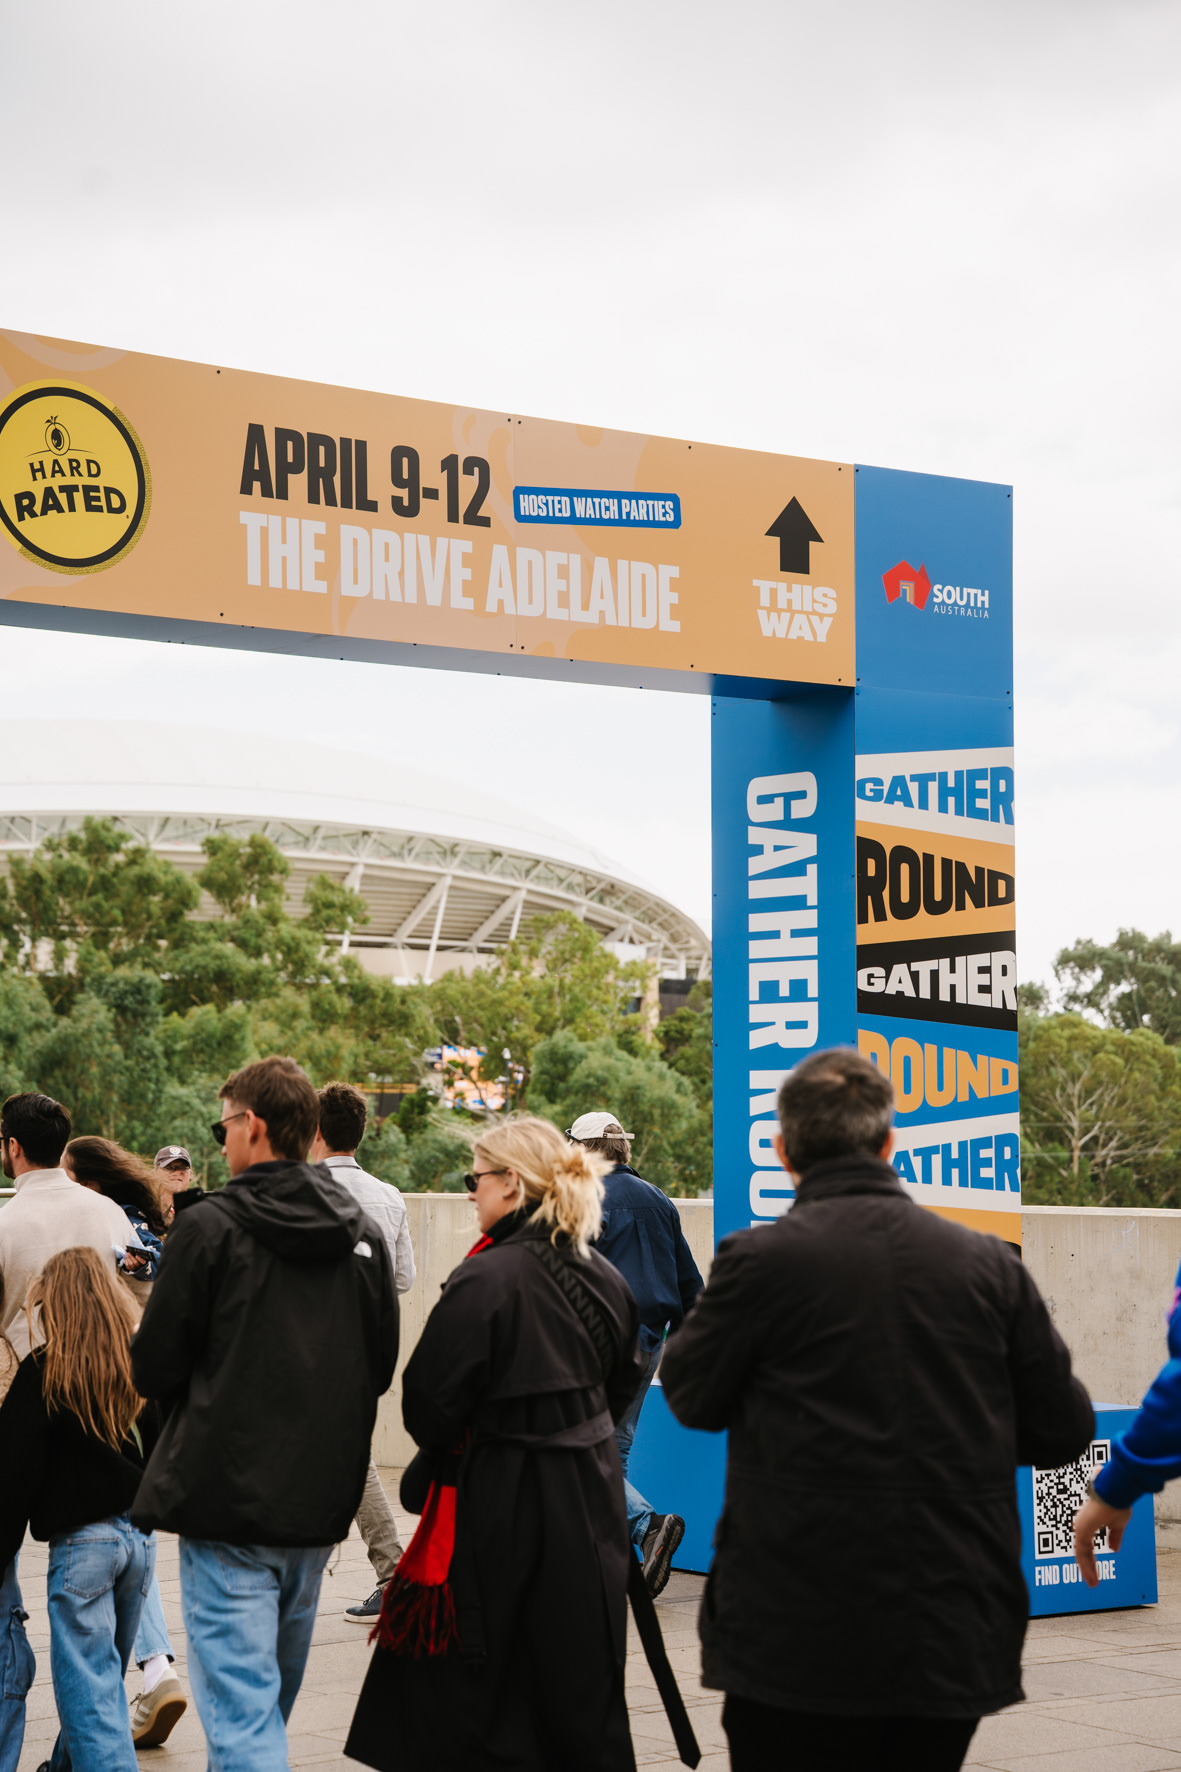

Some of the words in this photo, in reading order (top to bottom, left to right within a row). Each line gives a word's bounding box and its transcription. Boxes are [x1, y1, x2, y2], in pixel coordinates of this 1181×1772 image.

[29, 458, 101, 482] HARD
[240, 423, 378, 513] APRIL
[391, 445, 491, 528] 9-12
[14, 484, 126, 522] RATED
[519, 494, 570, 517] HOSTED
[573, 496, 619, 520] WATCH
[621, 498, 675, 522] PARTIES
[240, 511, 328, 594] THE
[340, 524, 475, 610] DRIVE
[485, 543, 681, 633] ADELAIDE
[752, 579, 837, 615] THIS
[933, 584, 989, 609] SOUTH
[933, 604, 989, 619] AUSTRALIA
[757, 609, 834, 642] WAY
[856, 766, 1014, 826] GATHER
[856, 835, 1015, 925] ROUND
[746, 771, 818, 1049] GATHER
[857, 950, 1018, 1011] GATHER
[891, 1132, 1020, 1193] ATHER
[1035, 1565, 1060, 1586] FIND
[1096, 1559, 1116, 1581] ORE
